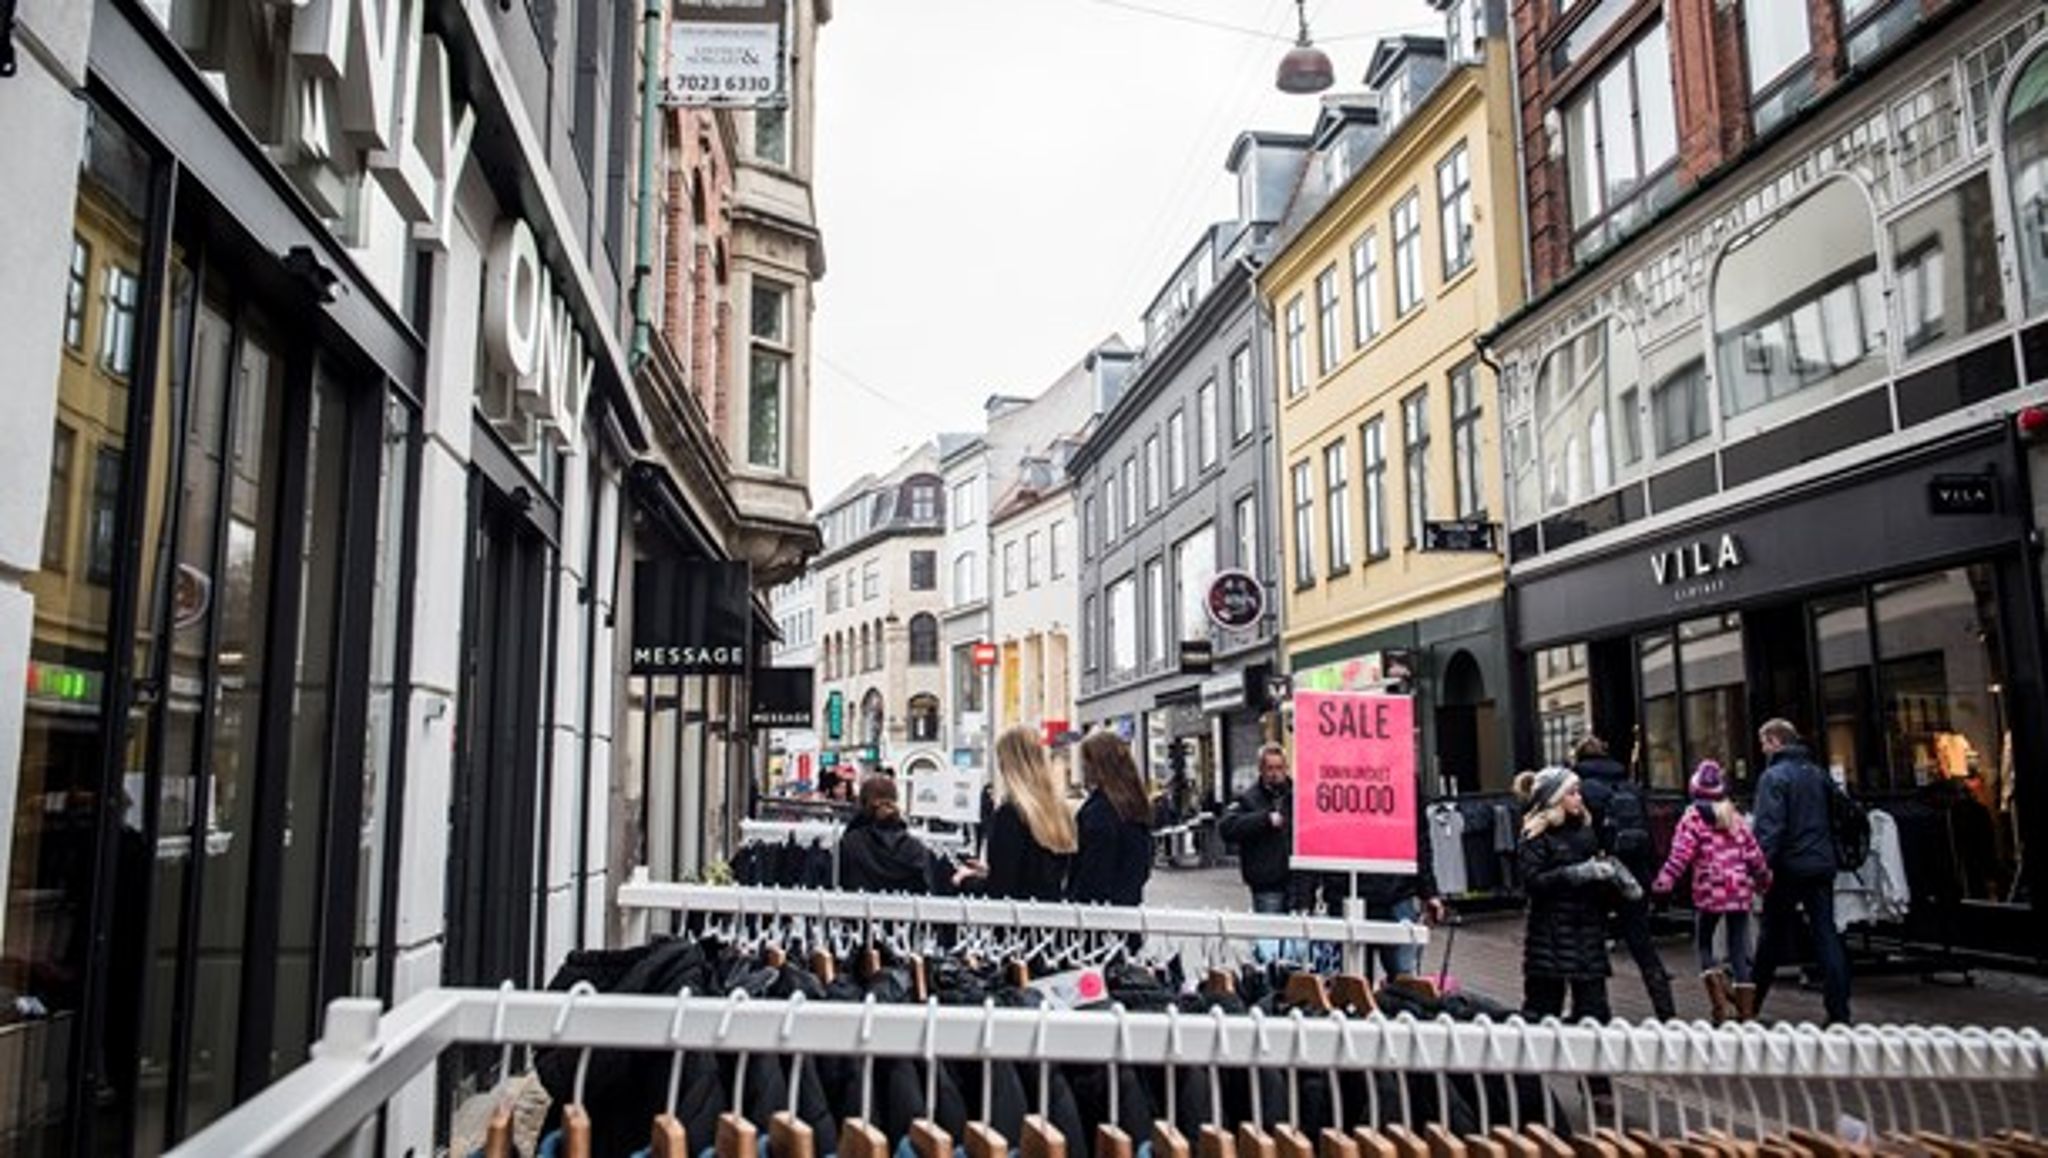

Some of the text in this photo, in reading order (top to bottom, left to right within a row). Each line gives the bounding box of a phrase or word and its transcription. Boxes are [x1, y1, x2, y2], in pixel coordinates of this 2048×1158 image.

[503, 218, 594, 456] ONLY
[1940, 489, 1985, 501] VILA
[1651, 533, 1739, 585] VILA
[633, 647, 743, 665] MESSAGE
[1318, 700, 1391, 739] SALE
[1316, 782, 1395, 816] 600.00
